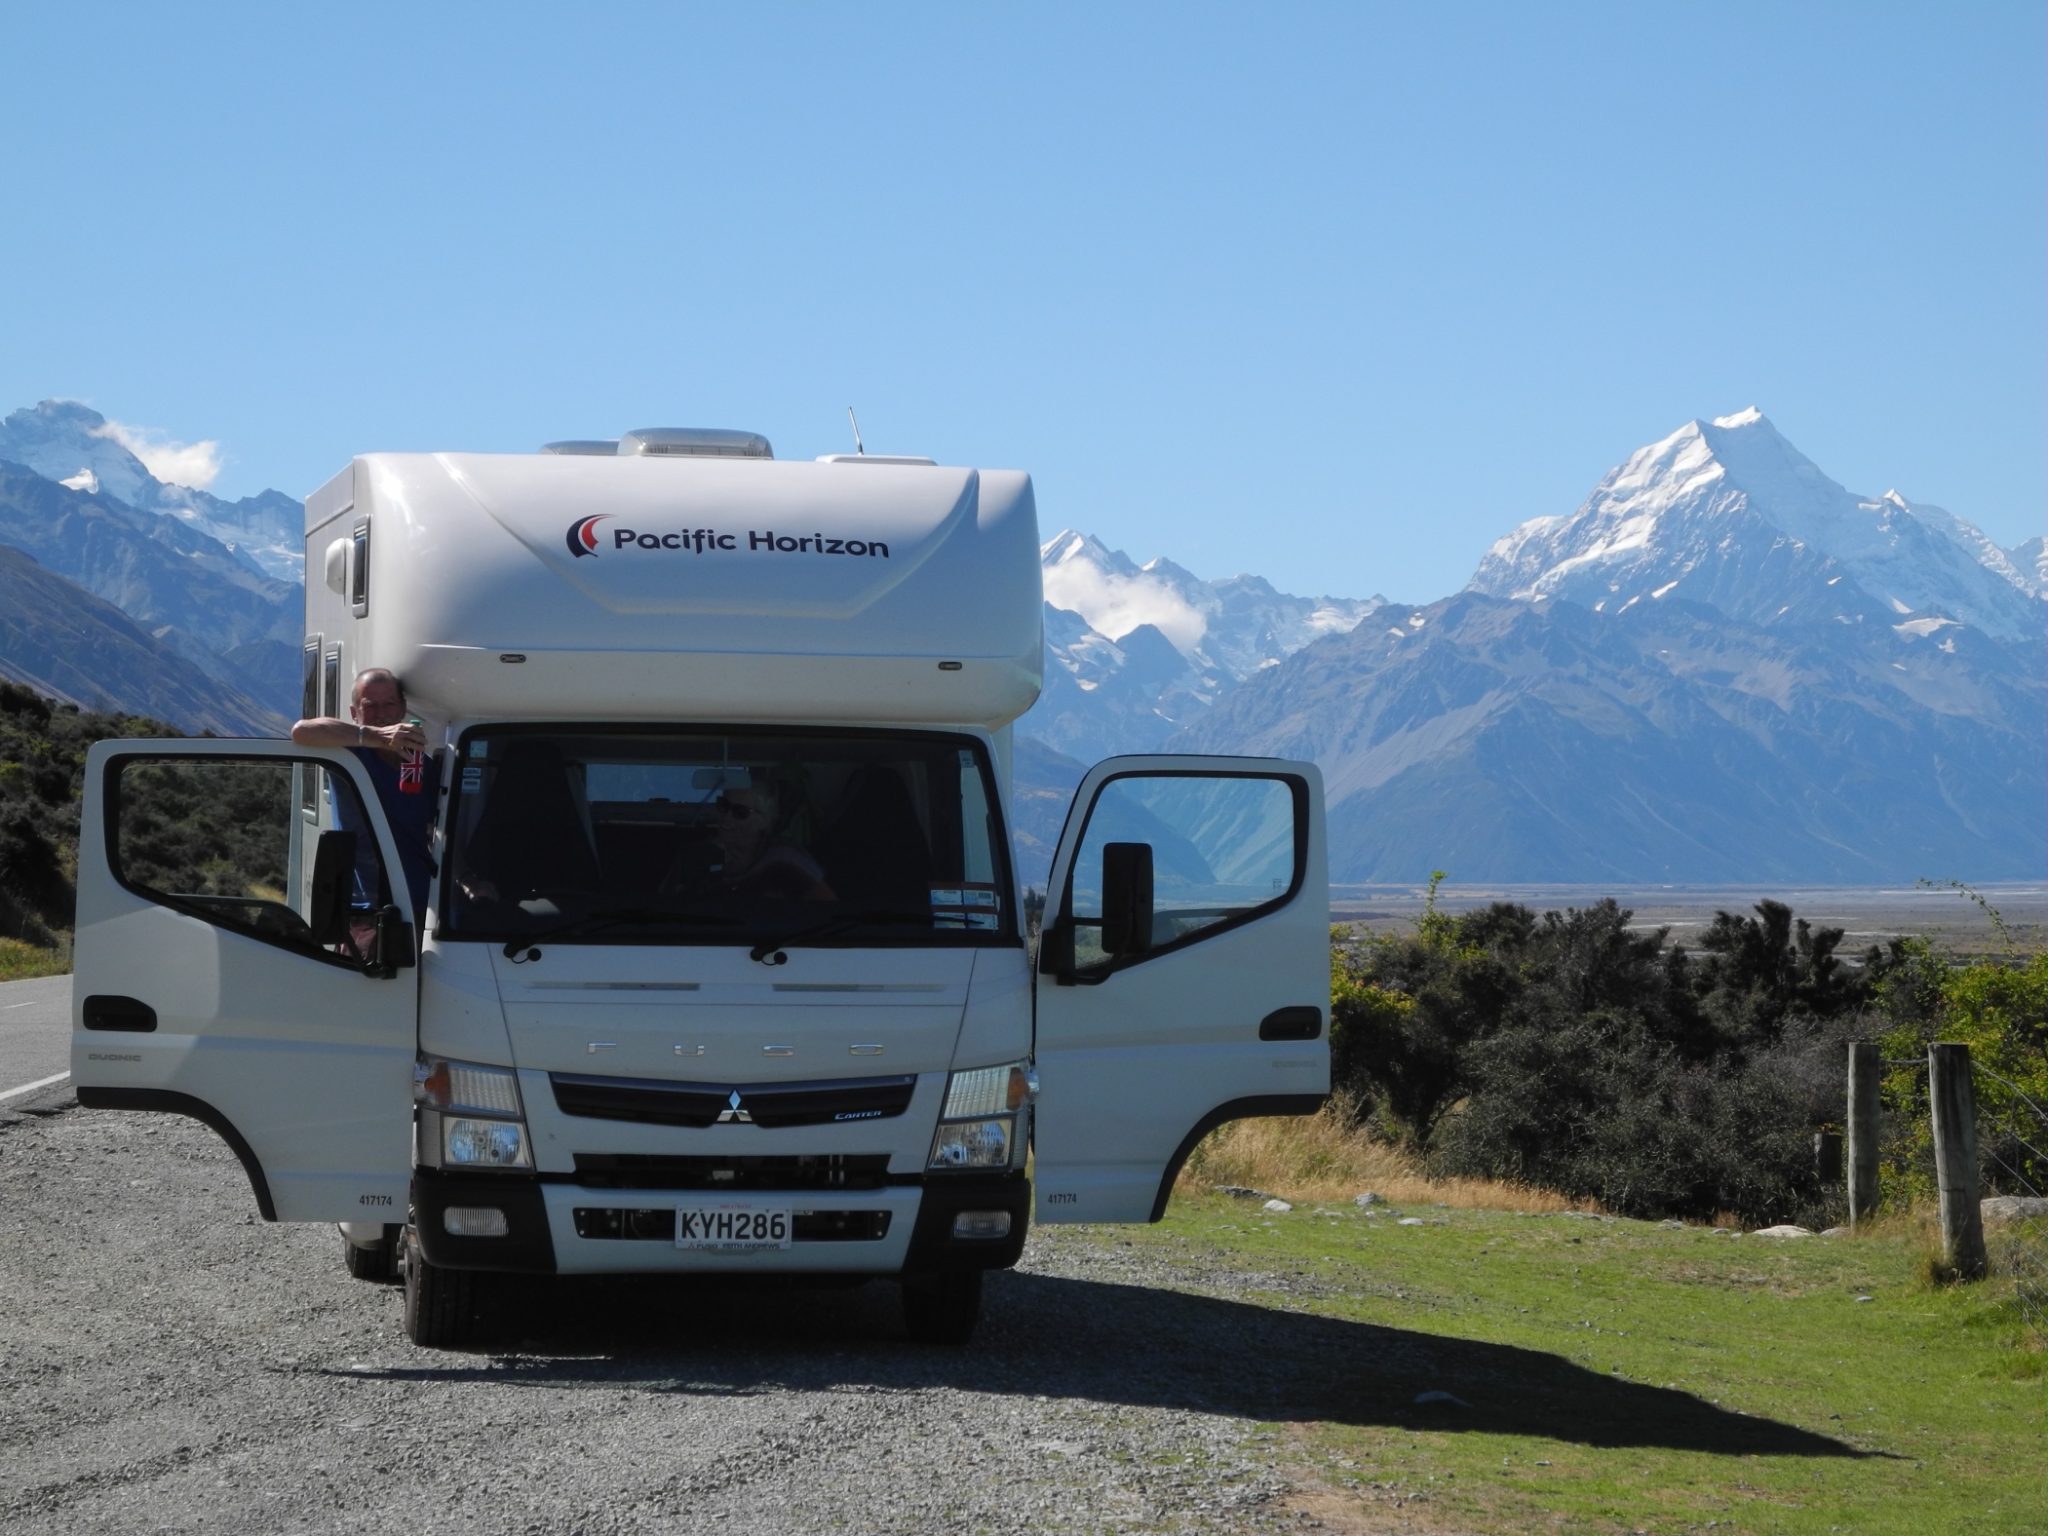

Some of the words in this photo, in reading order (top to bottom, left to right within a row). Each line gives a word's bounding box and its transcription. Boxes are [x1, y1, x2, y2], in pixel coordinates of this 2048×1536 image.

[613, 528, 737, 555] Pacific
[748, 530, 890, 558] Horizon
[587, 1041, 885, 1057] FUSO
[359, 1194, 393, 1207] 417174
[1047, 1192, 1077, 1205] 417174
[681, 1212, 786, 1240] KYH286
